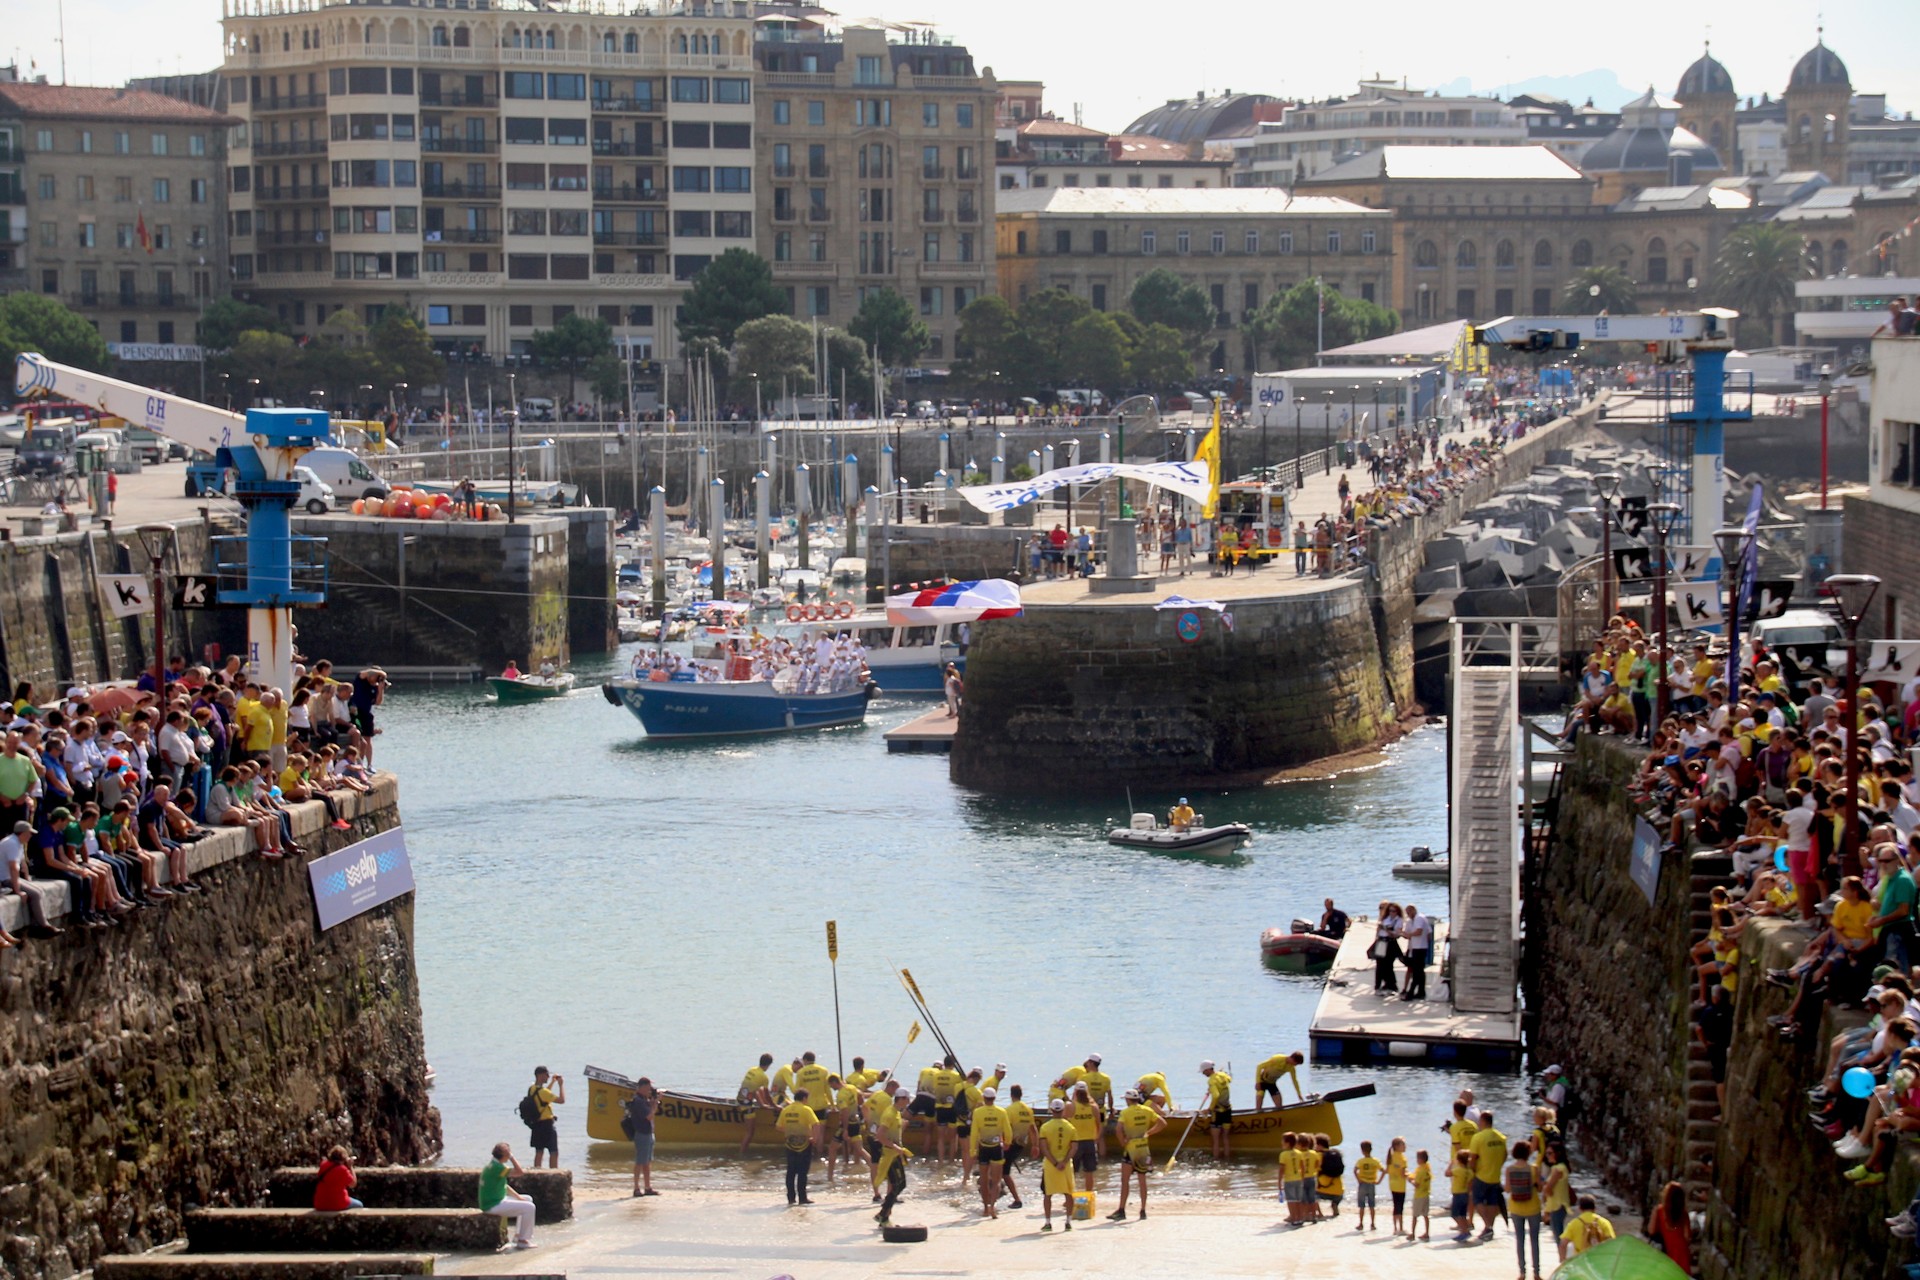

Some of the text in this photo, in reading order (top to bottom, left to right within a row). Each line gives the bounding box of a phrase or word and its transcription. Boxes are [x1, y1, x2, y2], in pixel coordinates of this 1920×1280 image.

[122, 346, 174, 360] PENSION
[1259, 385, 1284, 406] ekp
[146, 396, 166, 419] GH
[360, 849, 377, 883] ekp
[655, 1100, 749, 1124] Babyaut
[1194, 1117, 1283, 1135] SARDI
